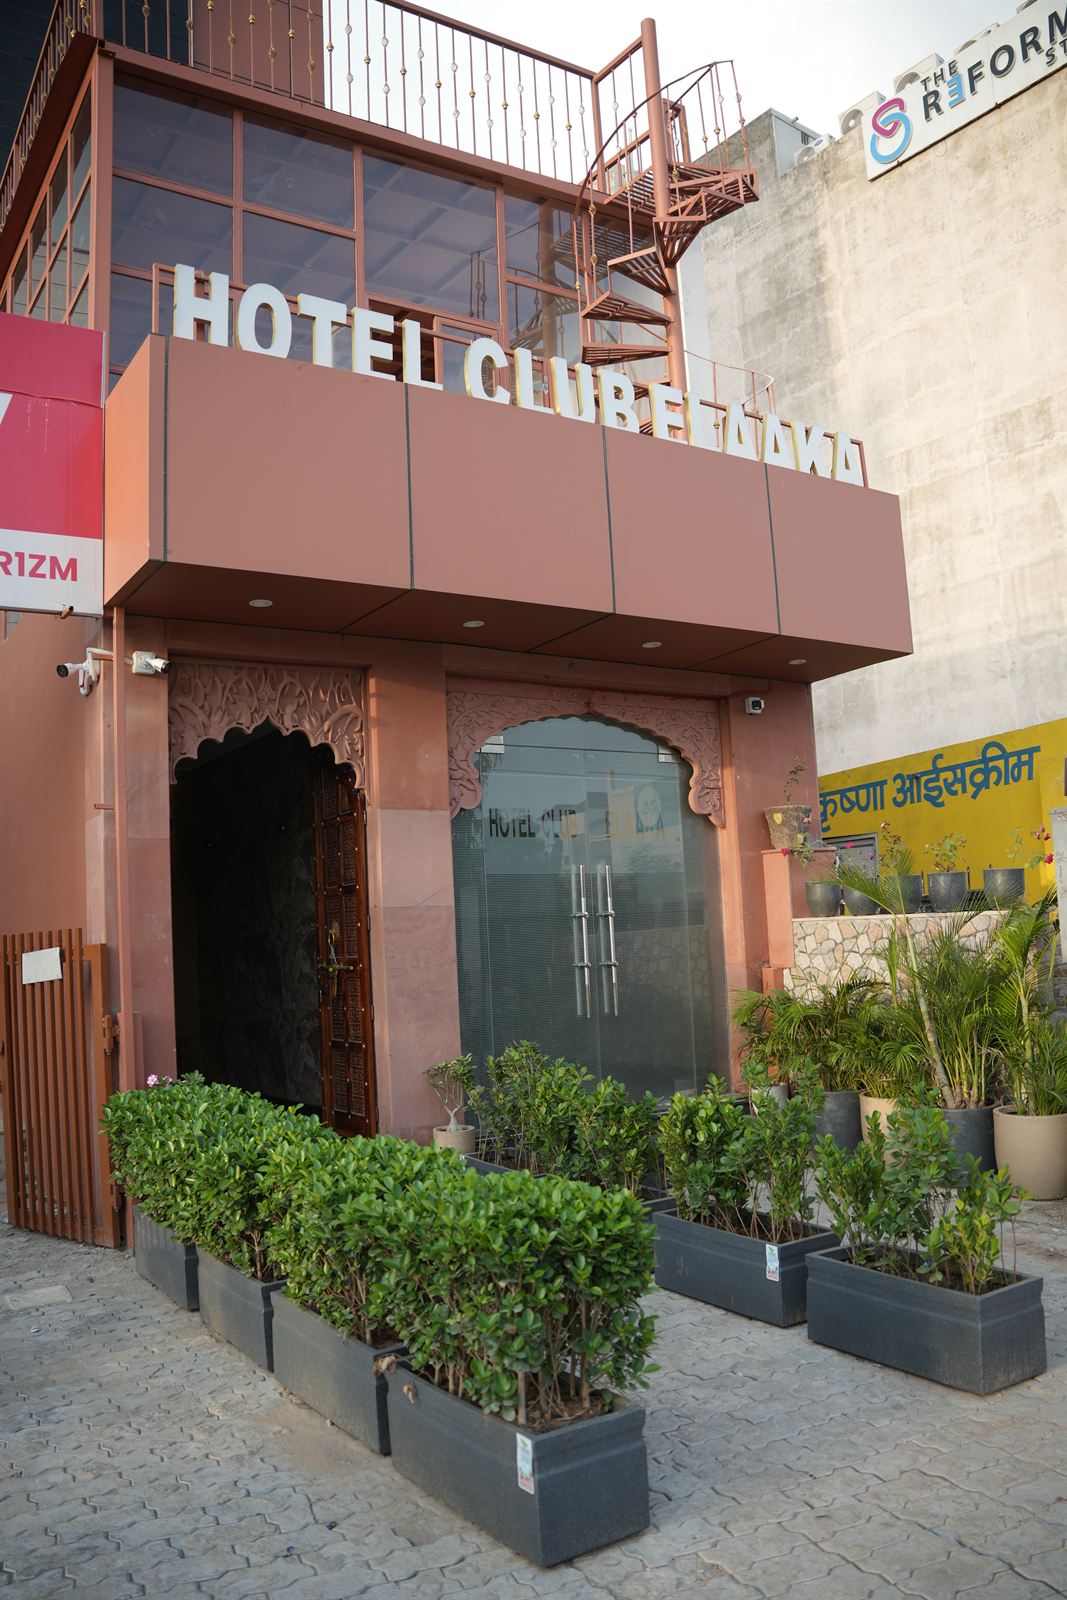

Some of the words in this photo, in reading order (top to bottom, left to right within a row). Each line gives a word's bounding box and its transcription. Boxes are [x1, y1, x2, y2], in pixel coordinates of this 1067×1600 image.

[920, 59, 961, 92] THE
[173, 263, 443, 391] HOTEL
[464, 338, 640, 434] CLUB
[648, 383, 866, 488] ELAAKA
[819, 779, 888, 833] कृष्णा
[892, 741, 1041, 808] आईसक्रीम
